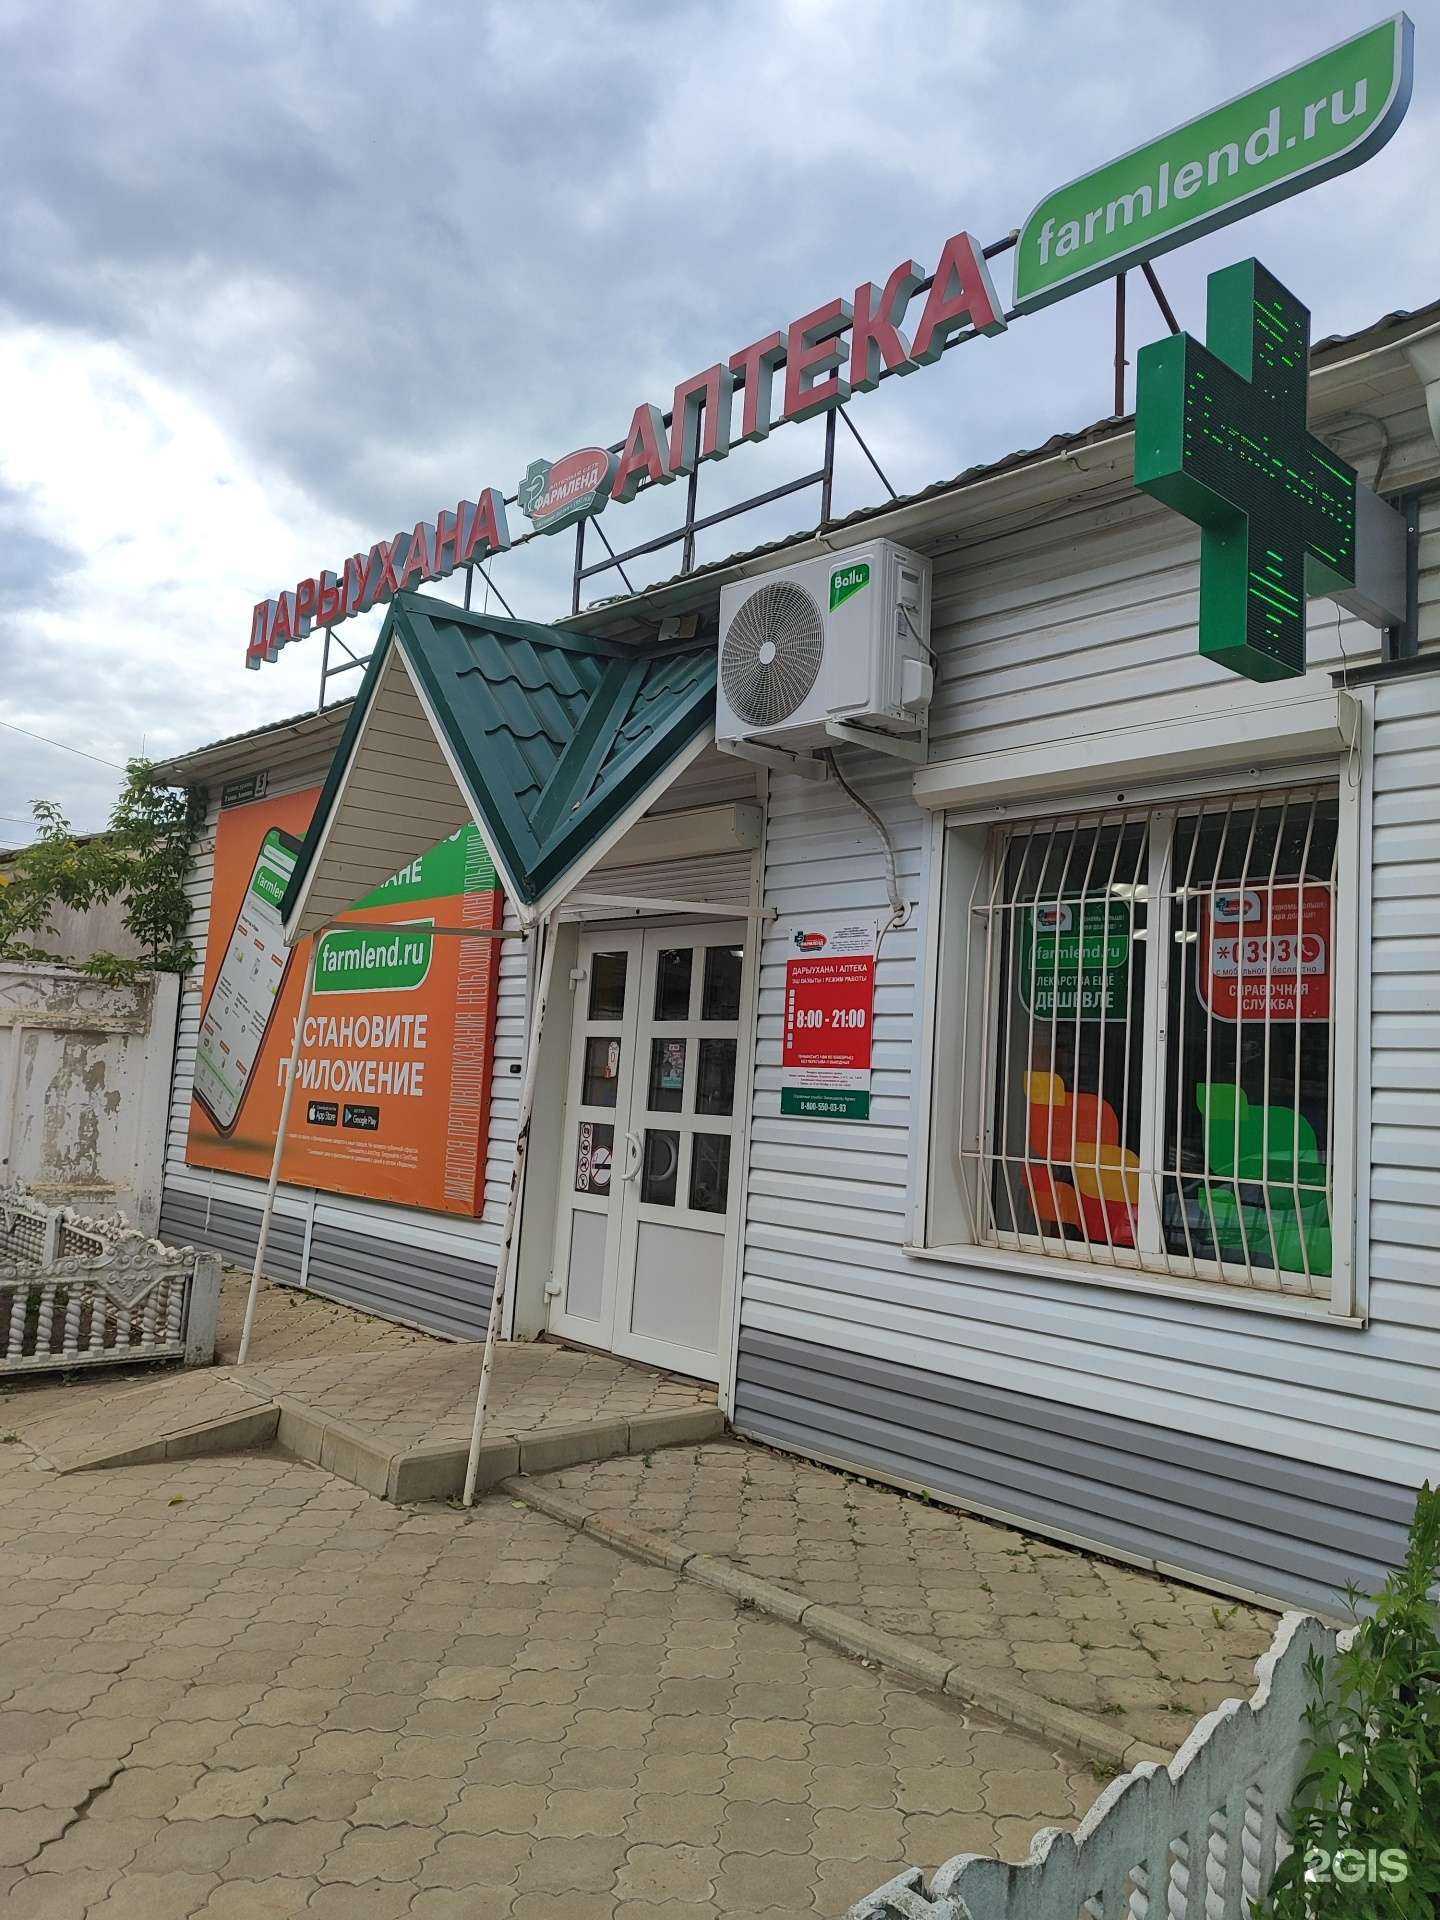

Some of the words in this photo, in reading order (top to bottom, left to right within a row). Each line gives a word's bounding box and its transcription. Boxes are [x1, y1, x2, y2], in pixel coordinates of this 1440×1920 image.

[1037, 78, 1368, 265] farmlend.ru
[611, 231, 1007, 504] АПТЕКА
[535, 468, 598, 510] ФАРМЛЕНД
[246, 487, 511, 670] ДАРЫУХАНА
[834, 570, 863, 589] Ballu
[322, 940, 424, 973] farmlend.ru
[792, 965, 834, 976] ДАРЫУХАНА
[839, 963, 867, 973] АПТЕКА
[1222, 967, 1268, 975] мобльного
[1272, 966, 1317, 974] бесплтно
[1229, 983, 1309, 997] СРАВОЧНАЯ
[291, 1015, 428, 1048] УСТАНОВИТЕ
[797, 1008, 823, 1029] 8:00
[831, 1008, 866, 1029] 21:00
[277, 1058, 425, 1097] ПРИЛОЖЕНИЕ
[352, 1114, 367, 1126] Google
[443, 1141, 476, 1202] ИМЕЮТСЯ
